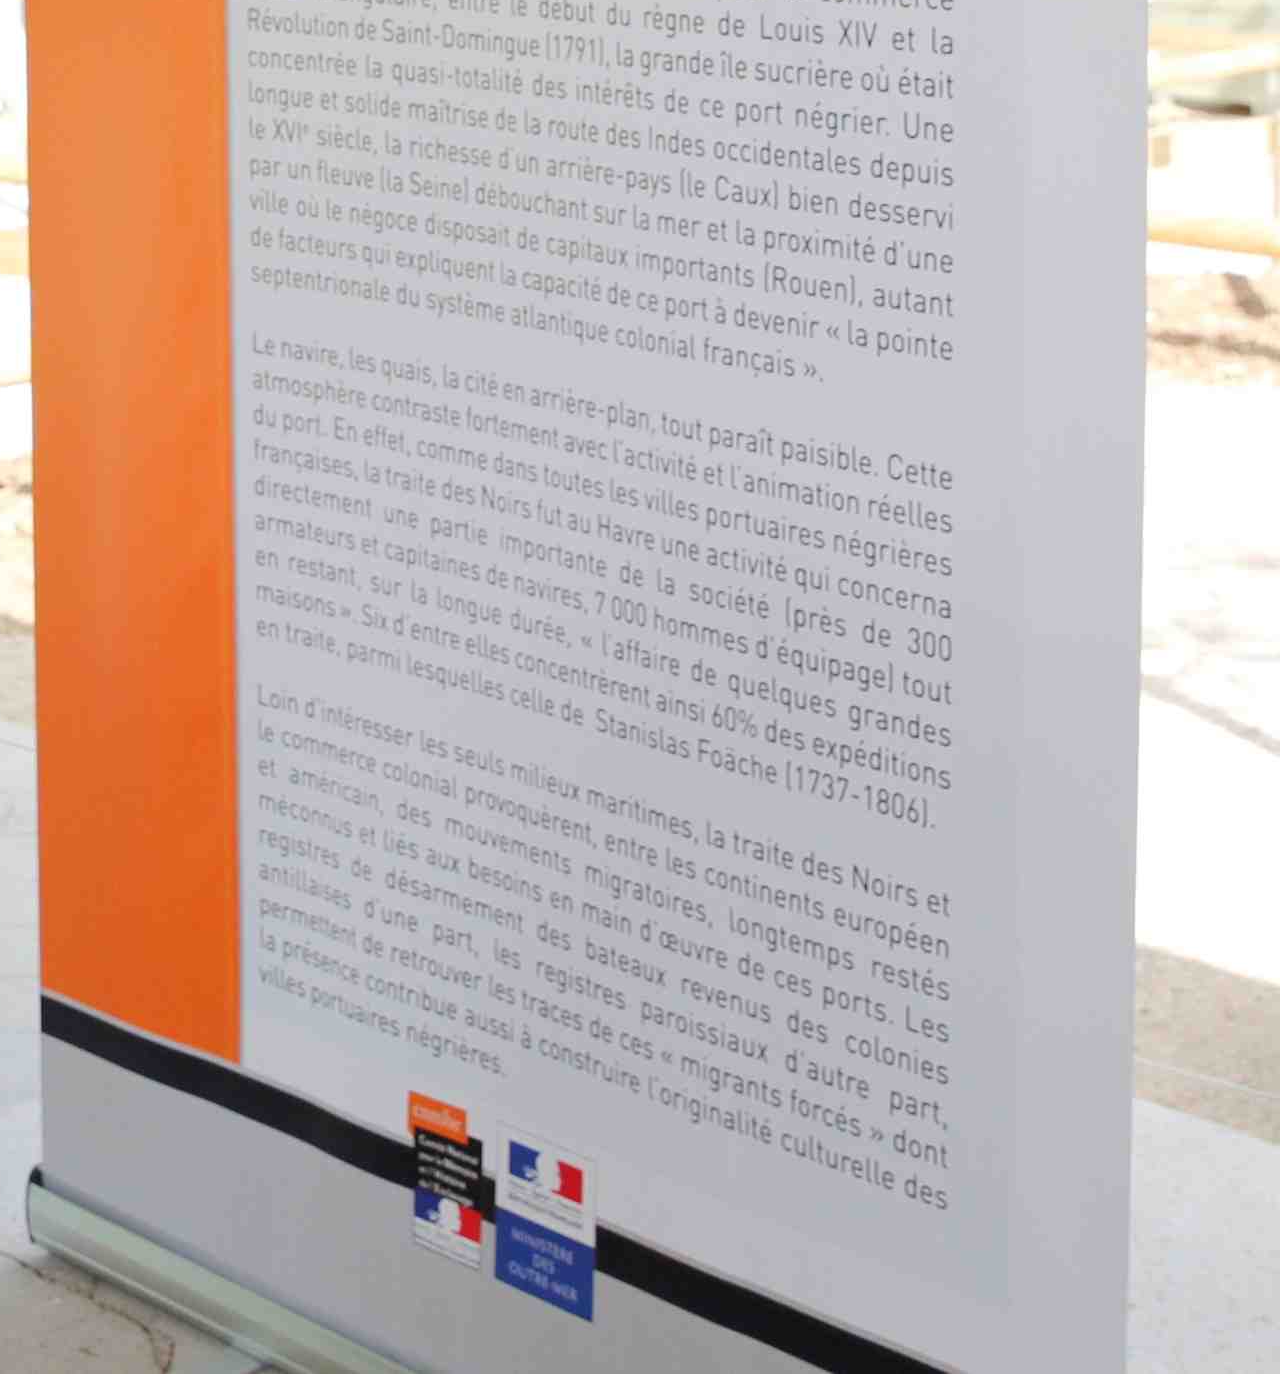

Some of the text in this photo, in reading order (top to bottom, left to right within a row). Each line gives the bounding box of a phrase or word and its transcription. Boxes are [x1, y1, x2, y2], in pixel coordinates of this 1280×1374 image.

[247, 7, 350, 38] Révolution
[352, 14, 378, 40] de
[380, 16, 541, 60] Saint-Domingue
[614, 38, 635, 67] la
[638, 46, 715, 76] grande
[719, 48, 748, 79] île
[753, 57, 853, 89] sucrière
[858, 62, 891, 92] où
[896, 64, 955, 97] était
[642, 0, 706, 37] règne
[716, 7, 746, 37] de
[758, 11, 824, 44] Louis
[837, 17, 878, 48] XIV
[890, 24, 916, 50] et
[930, 23, 955, 53] la
[247, 48, 956, 142] concentrée la quasi-totalité des intérêts de ce port négrier. Une
[248, 79, 955, 189] longue et solide maîtrise de la route des Indes occidentales depuis
[248, 115, 267, 140] le
[384, 128, 403, 155] la
[407, 134, 492, 168] richesse
[544, 153, 672, 198] arrière-pays
[678, 168, 707, 199] (le
[713, 172, 779, 212] Caux)
[787, 182, 839, 216] bien
[847, 190, 954, 230] desservi
[252, 468, 953, 662] directement une partie importante de la société (près de 300
[253, 544, 279, 568] en
[366, 571, 403, 599] sur
[409, 576, 429, 606] la
[434, 583, 502, 626] longue
[509, 603, 572, 649] durée,
[689, 652, 717, 686] de
[726, 669, 838, 719] quelques
[846, 700, 954, 748] grandes
[255, 615, 280, 638] en
[345, 638, 401, 671] parmi
[405, 648, 505, 702] lesquelles
[509, 684, 555, 717] celle
[559, 693, 584, 726] de
[593, 703, 691, 758] Stanislas
[418, 725, 449, 759] les
[452, 742, 505, 777] seuls
[509, 760, 581, 802] milieux
[704, 816, 726, 849] la
[731, 827, 794, 870] traite
[800, 845, 844, 885] des
[850, 860, 920, 908] Noirs
[925, 889, 952, 917] et
[492, 936, 523, 972] les
[535, 958, 627, 1011] registres
[639, 997, 769, 1064] paroissiaux
[535, 914, 572, 952] des
[584, 931, 667, 987] bateaux
[680, 972, 772, 1025] revenus
[785, 1003, 829, 1045] des
[843, 1030, 950, 1086] colonies
